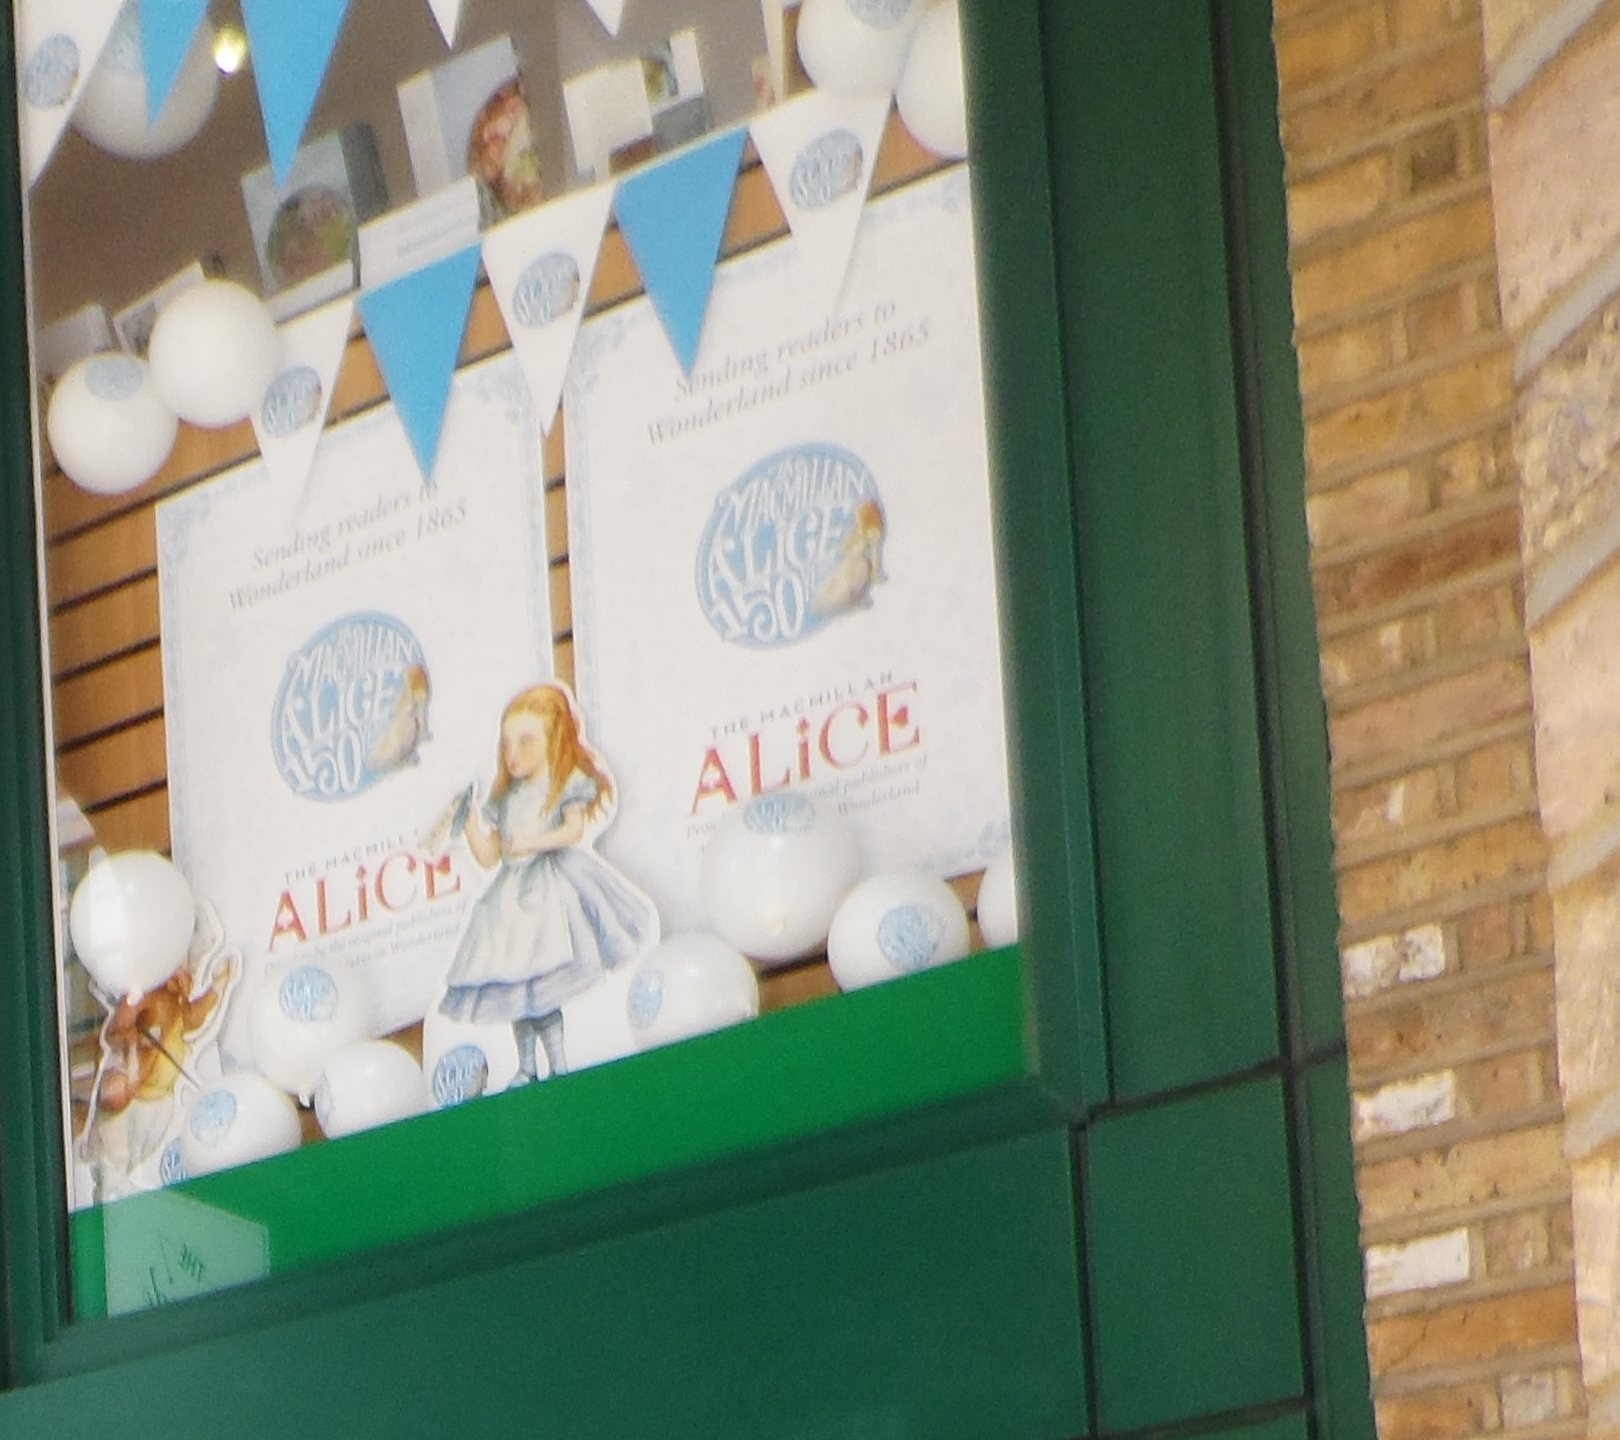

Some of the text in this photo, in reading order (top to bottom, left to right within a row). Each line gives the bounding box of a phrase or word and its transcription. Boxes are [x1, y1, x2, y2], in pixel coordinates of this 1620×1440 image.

[648, 314, 929, 445] Wonderland since 1865
[675, 352, 768, 400] Sending
[778, 317, 863, 363] readers
[230, 499, 466, 610] Wonderland since 1865
[252, 526, 330, 572] Sending
[338, 493, 410, 535] readers
[710, 670, 894, 739] THE MACMILLAN
[285, 863, 317, 885] THE
